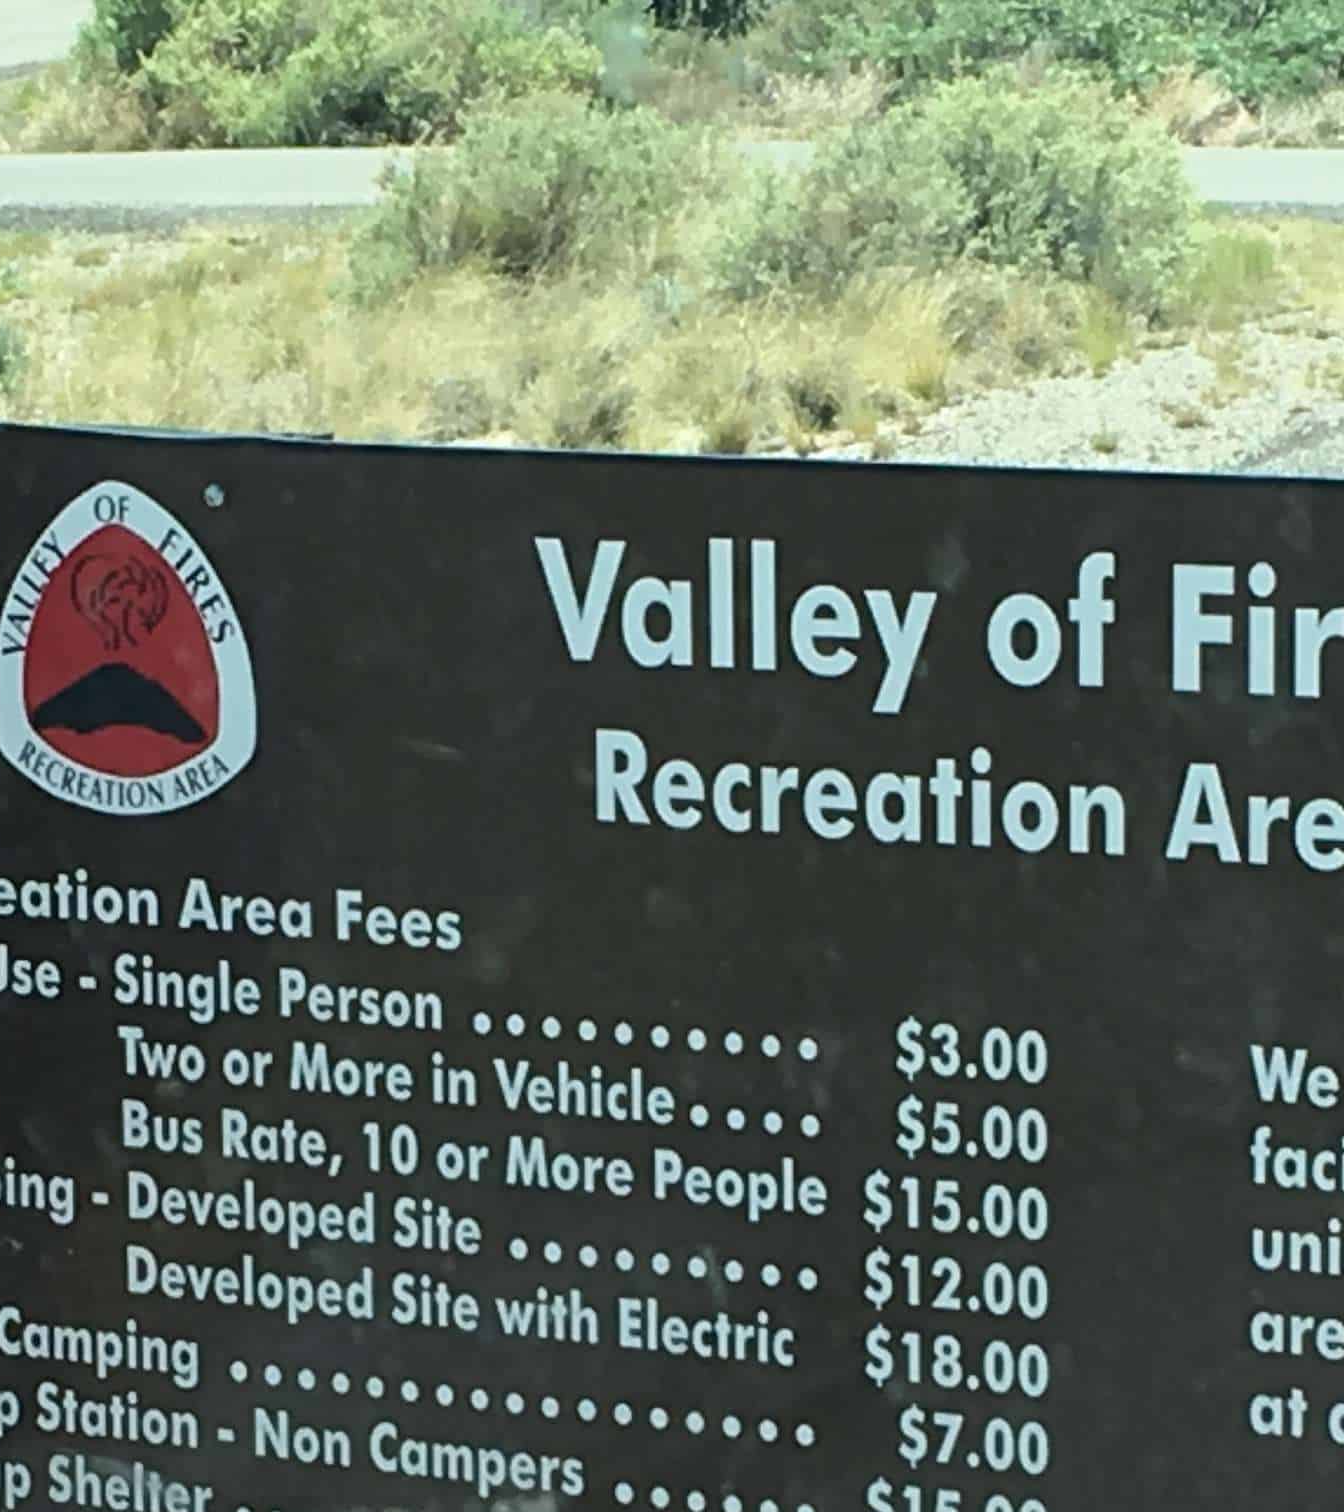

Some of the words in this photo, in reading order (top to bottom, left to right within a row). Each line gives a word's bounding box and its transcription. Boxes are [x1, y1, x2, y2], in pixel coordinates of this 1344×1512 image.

[1, 530, 65, 657] VALLEY
[93, 496, 130, 523] OF
[157, 529, 235, 644] FIRES
[534, 536, 938, 715] Valley
[986, 551, 1116, 687] of
[16, 740, 165, 809] RECREATION
[173, 753, 230, 801] AREA
[595, 727, 1126, 856] Recreation
[177, 877, 313, 939] Area
[335, 888, 462, 951] Fees
[114, 952, 262, 1025] Single
[278, 967, 443, 1031] Person
[895, 1015, 1048, 1084] $3.00
[1250, 1044, 1341, 1109] We
[118, 1025, 205, 1082] Two
[222, 1048, 274, 1088] or
[289, 1040, 414, 1102] More
[431, 1050, 477, 1107] in
[492, 1057, 676, 1126] Vehicle
[895, 1093, 1048, 1163] $5.00
[121, 1098, 204, 1155] Bus
[220, 1107, 343, 1177] Rate,
[362, 1121, 419, 1177] 10
[436, 1142, 490, 1182] or
[505, 1135, 635, 1197] More
[653, 1147, 828, 1223] People
[863, 1168, 1048, 1241] $15.00
[127, 1170, 376, 1251] Developed
[393, 1196, 482, 1255] Site
[863, 1245, 1049, 1320] $12.00
[126, 1244, 375, 1325] Developed
[391, 1271, 481, 1332] Site
[494, 1285, 600, 1345] with
[618, 1296, 795, 1367] Electric
[864, 1322, 1049, 1398] $18.00
[36, 1381, 199, 1449] Station
[254, 1407, 351, 1468] Non
[369, 1421, 585, 1499] Campers
[898, 1402, 1049, 1475] $7.00
[1249, 1387, 1309, 1439] at
